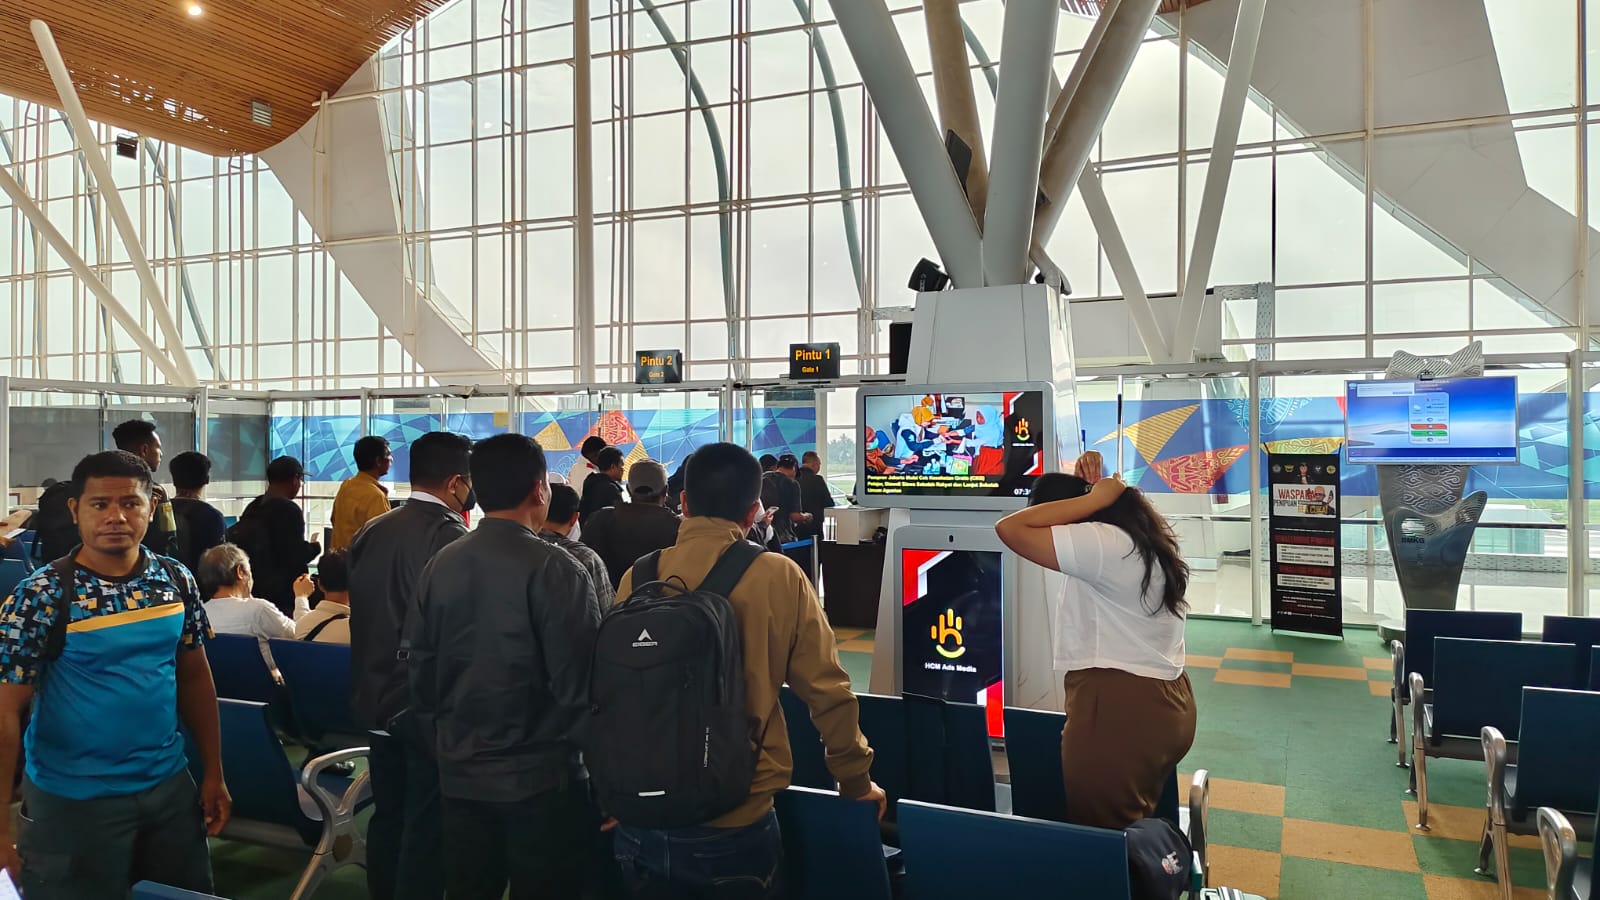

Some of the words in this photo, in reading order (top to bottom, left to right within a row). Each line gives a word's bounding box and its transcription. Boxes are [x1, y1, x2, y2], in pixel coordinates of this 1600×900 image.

[795, 349, 822, 361] Pintu
[825, 348, 831, 360] 1
[640, 356, 665, 367] Pintu
[666, 355, 673, 366] 2
[924, 662, 941, 670] HCM
[956, 664, 977, 672] Media
